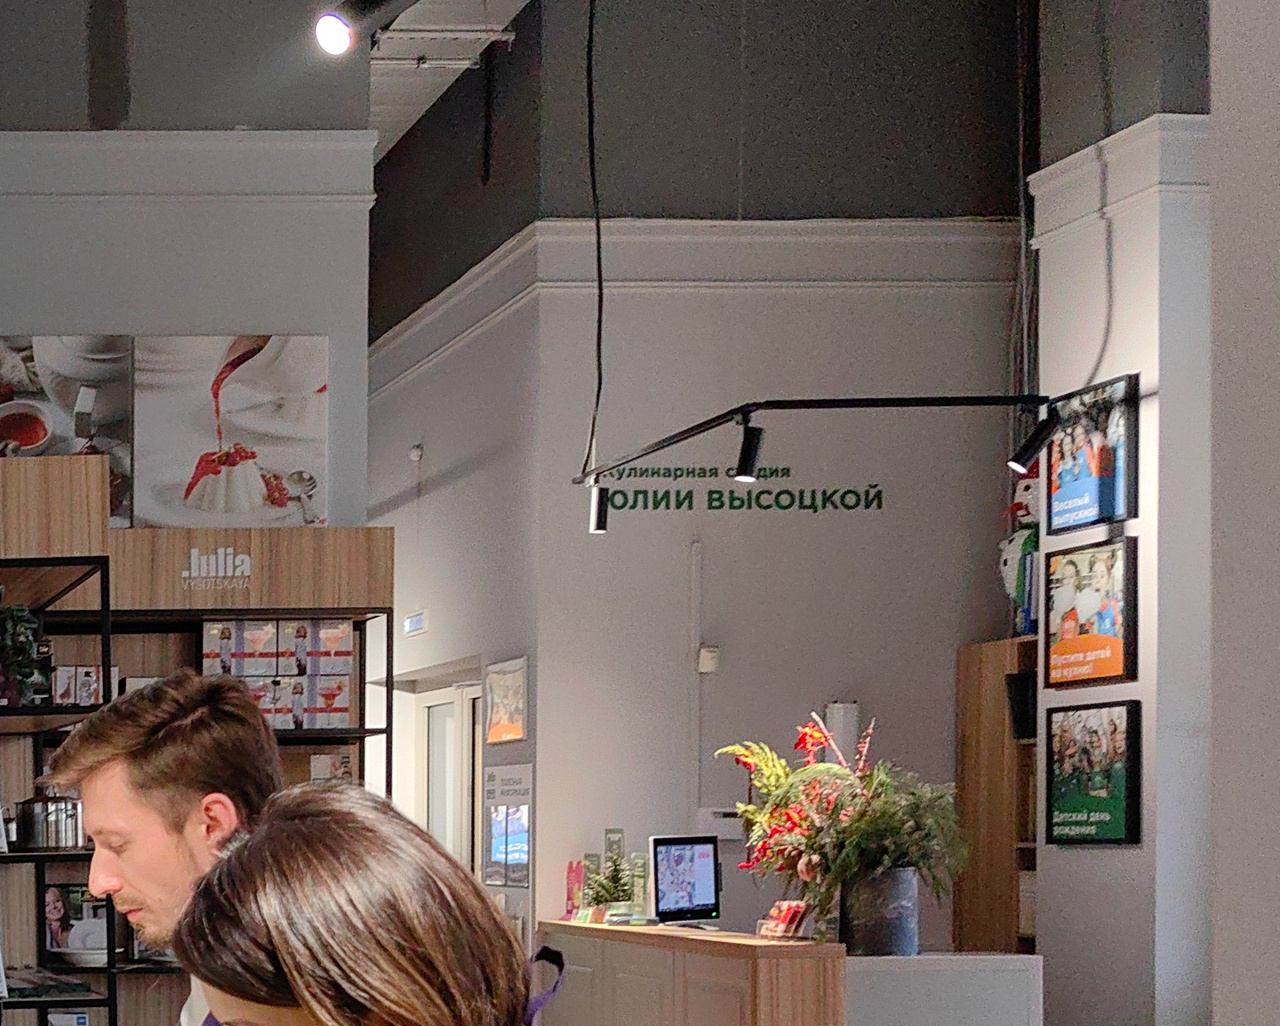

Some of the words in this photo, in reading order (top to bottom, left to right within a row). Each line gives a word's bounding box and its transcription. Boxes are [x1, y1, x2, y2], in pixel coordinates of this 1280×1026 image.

[604, 465, 719, 481] улинарная
[725, 466, 791, 480] сдия
[707, 483, 883, 513] ВЫСОЦКОЙ
[181, 547, 251, 577] Julia
